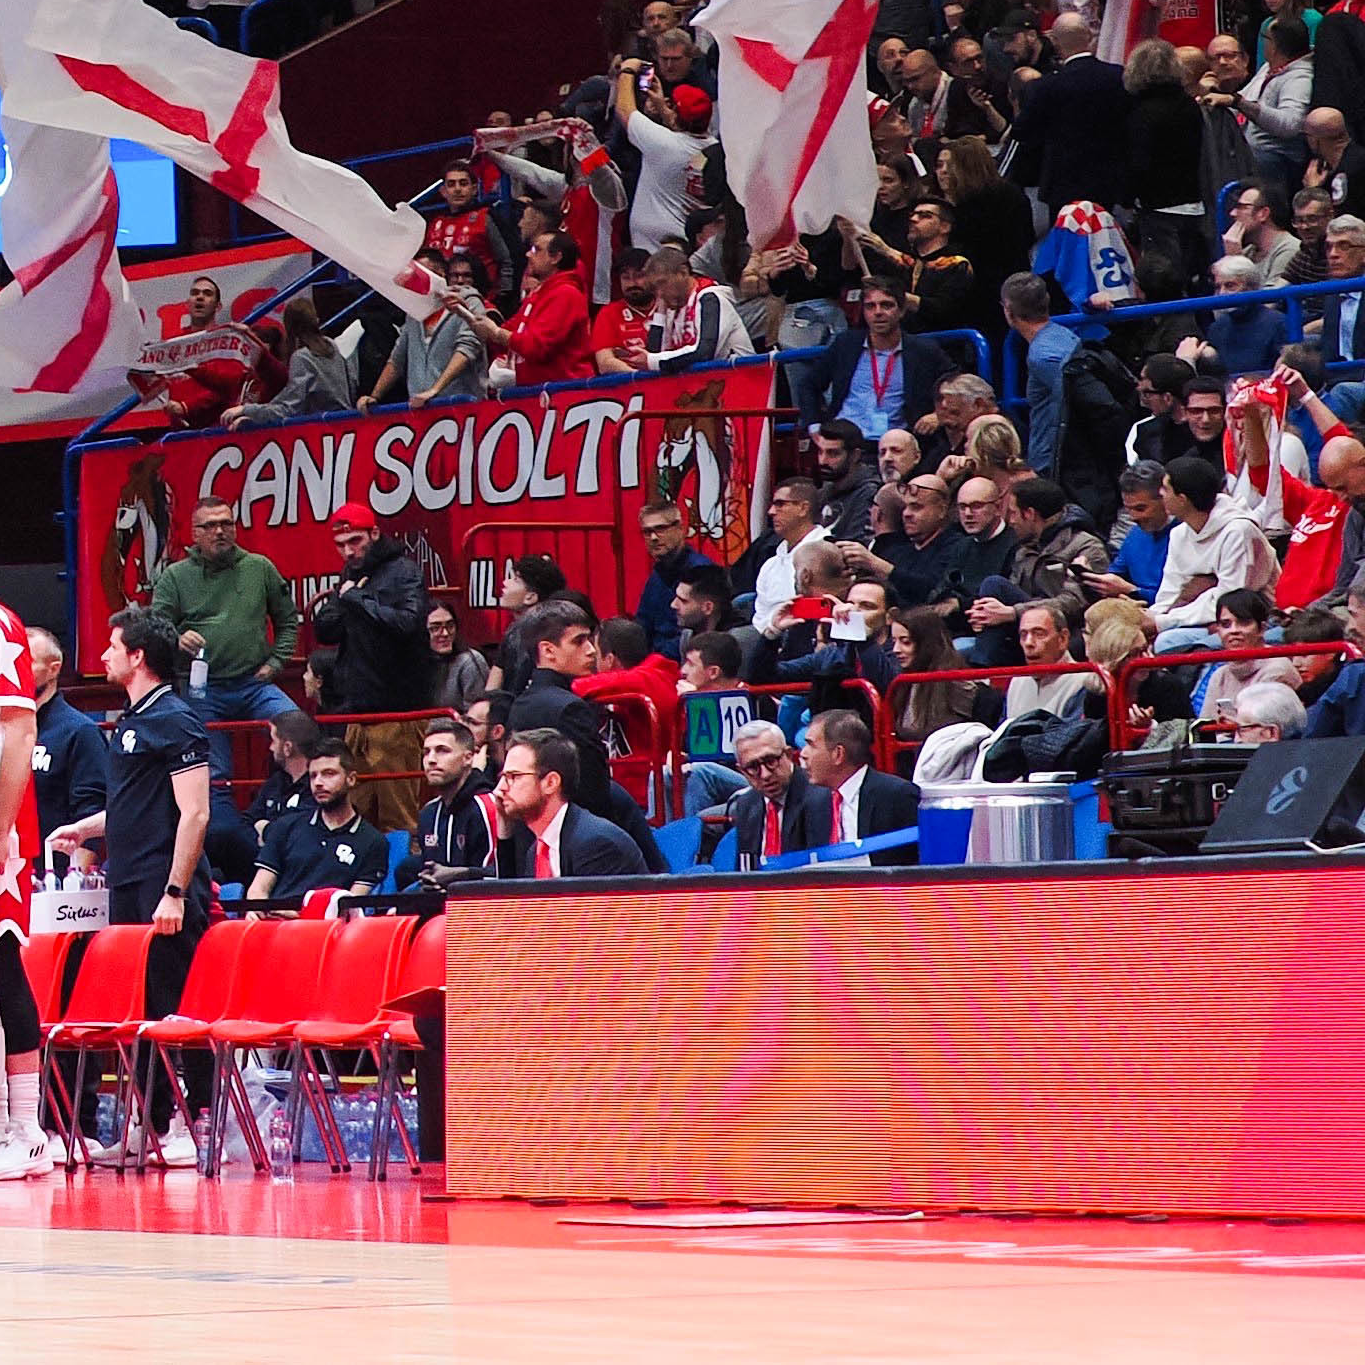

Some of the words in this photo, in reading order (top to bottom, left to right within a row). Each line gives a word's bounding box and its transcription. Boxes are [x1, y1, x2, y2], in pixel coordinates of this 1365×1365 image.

[198, 432, 356, 529] CANI
[368, 394, 645, 517] SCIOLTI
[695, 706, 715, 746] A
